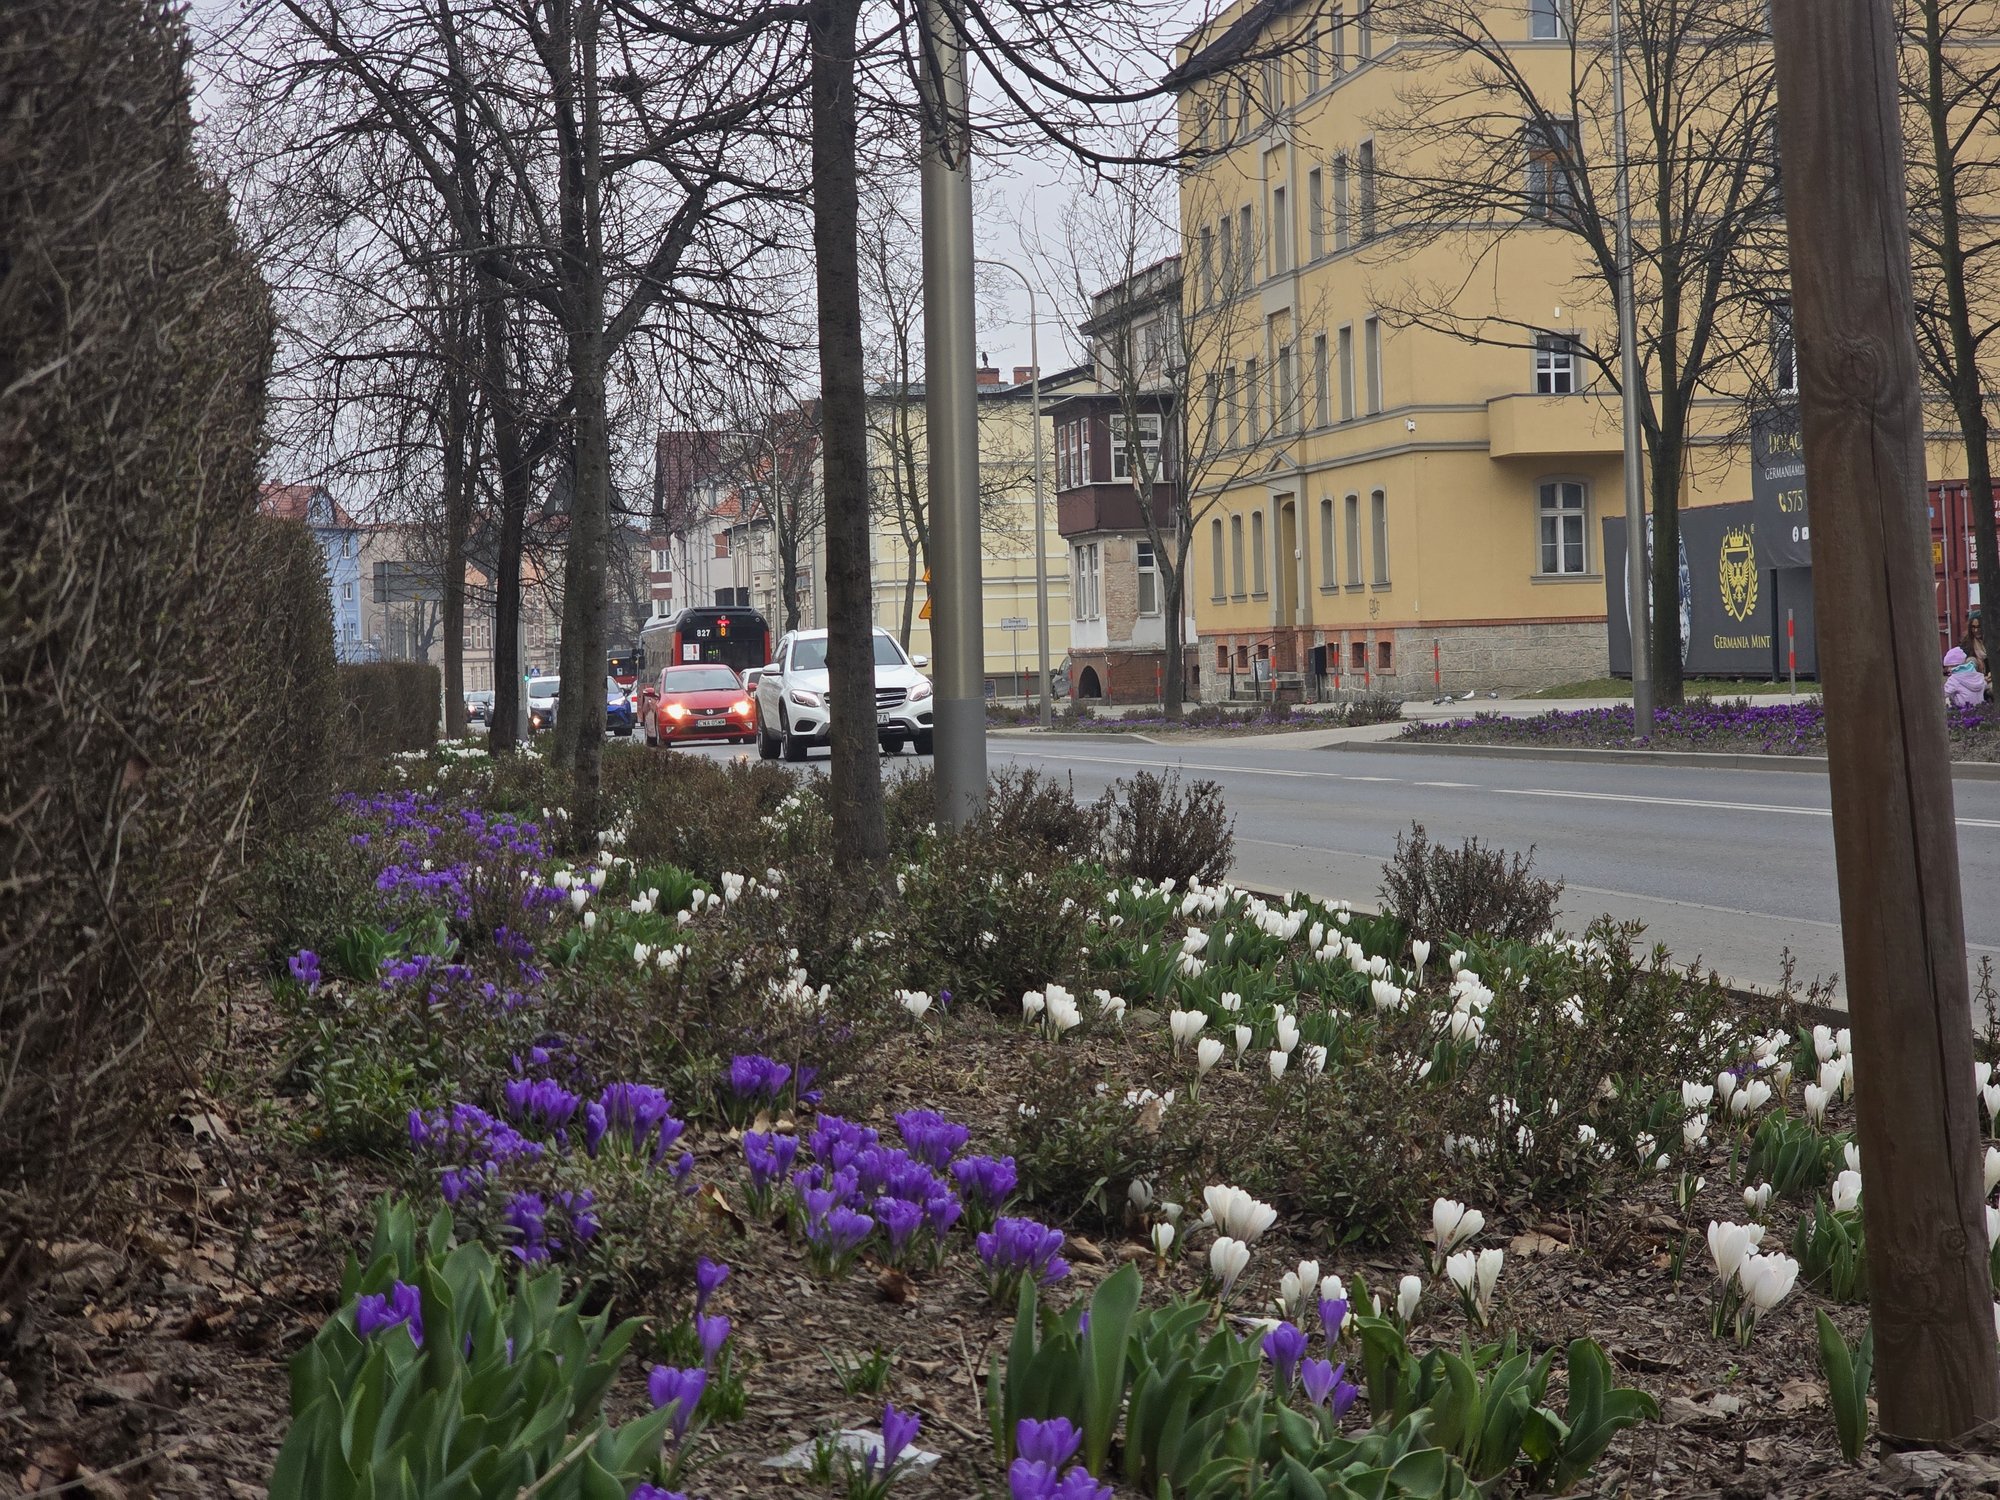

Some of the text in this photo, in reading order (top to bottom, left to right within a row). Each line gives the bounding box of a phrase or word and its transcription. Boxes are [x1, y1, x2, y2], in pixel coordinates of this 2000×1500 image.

[1769, 431, 1803, 456] DOŁĄC
[1787, 489, 1803, 512] 575
[696, 629, 711, 637] 827
